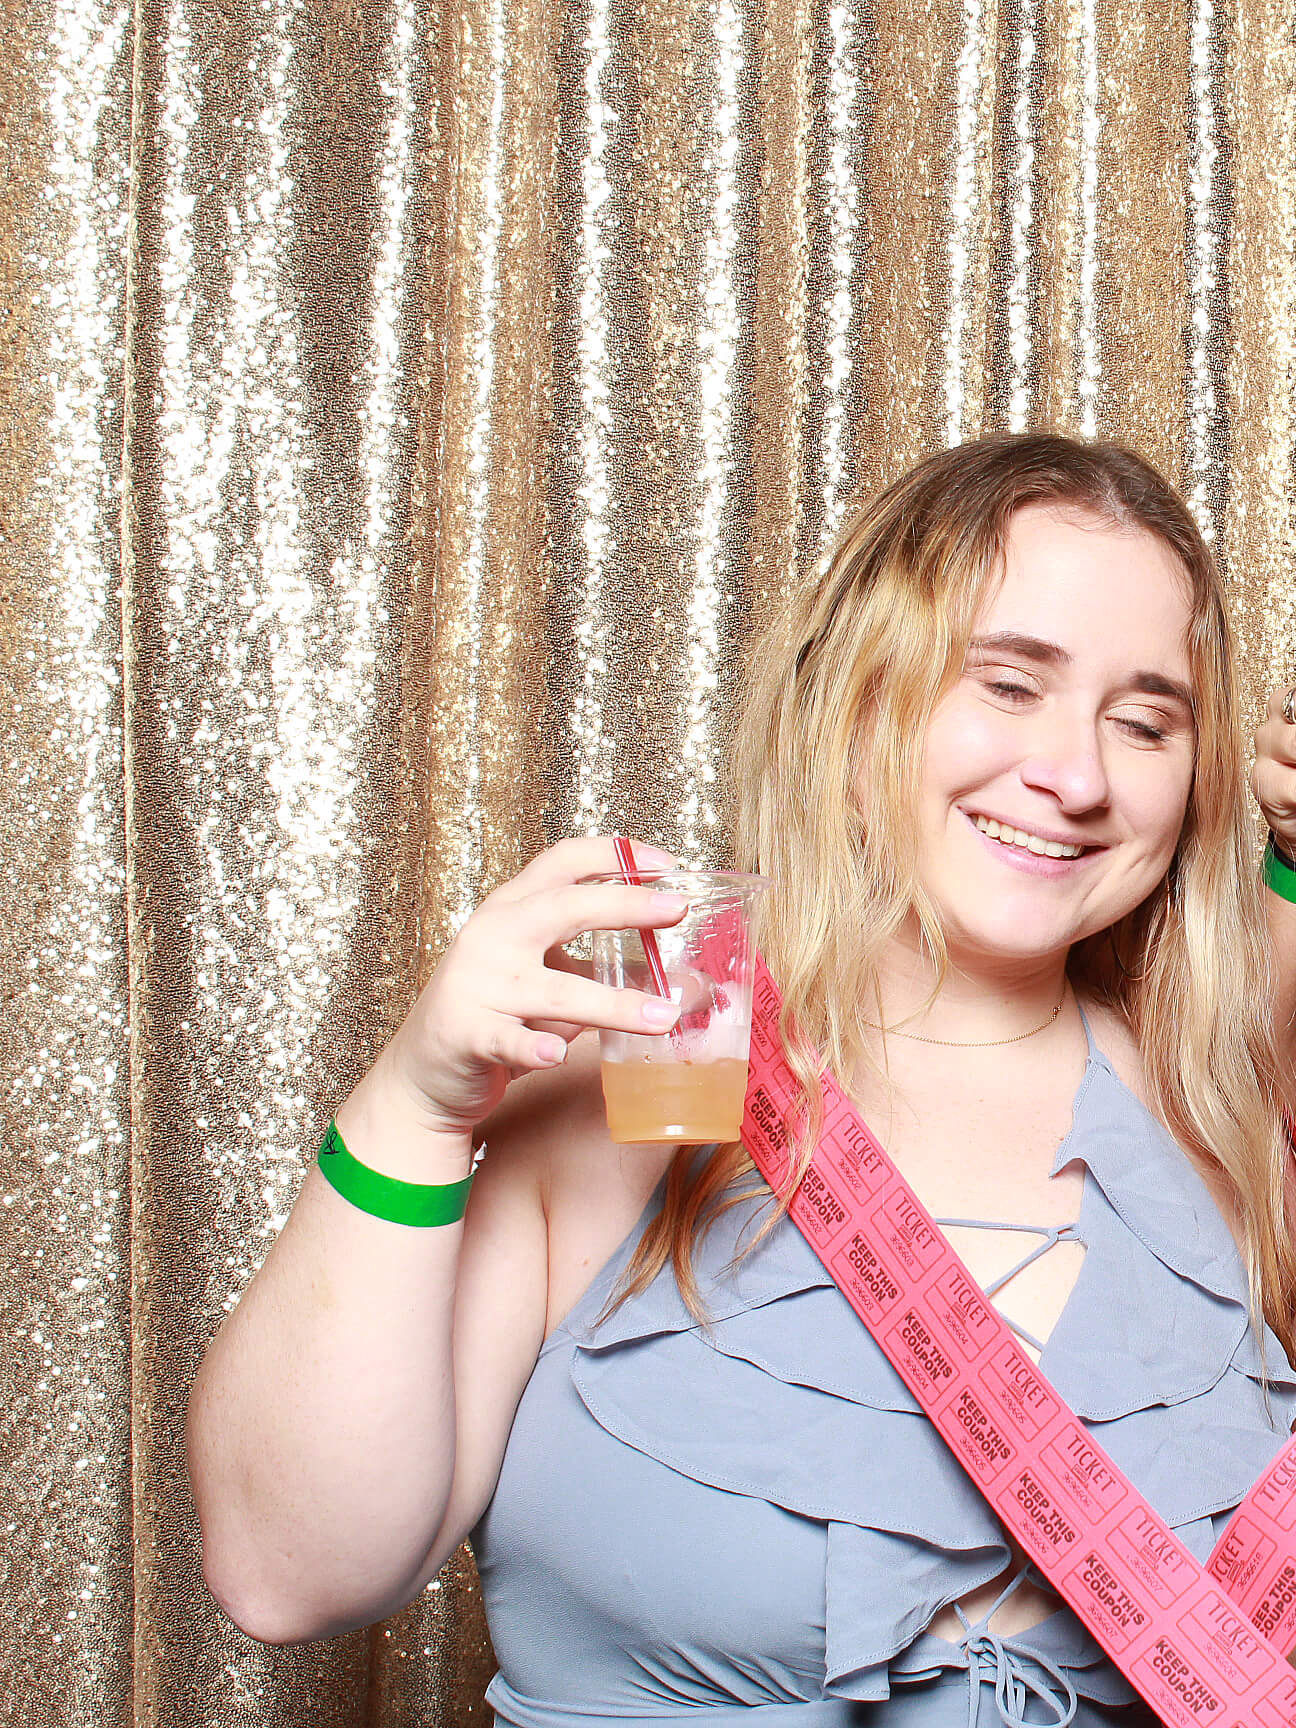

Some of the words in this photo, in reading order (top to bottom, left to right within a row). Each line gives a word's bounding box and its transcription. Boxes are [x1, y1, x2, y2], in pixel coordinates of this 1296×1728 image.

[748, 1102, 784, 1151] COUPON
[754, 1088, 777, 1120] KEEP
[842, 1122, 882, 1174] TICKET
[805, 1163, 825, 1192] EEP
[823, 1193, 845, 1223] THIS
[893, 1197, 935, 1250] TICKET
[847, 1249, 886, 1301] COUPON
[851, 1234, 877, 1268] KEEP
[874, 1268, 898, 1300] THIS
[947, 1274, 989, 1327] TICKET
[900, 1326, 940, 1380] COUPON
[904, 1311, 931, 1346] KEEP
[929, 1346, 952, 1378] THIS
[1002, 1352, 1048, 1408] TICKET
[955, 1406, 998, 1461] COUPON
[960, 1391, 988, 1427] KEEP
[986, 1426, 1011, 1460] THIS
[1065, 1434, 1116, 1492] TICKET
[1016, 1488, 1062, 1545] COUPON
[1019, 1472, 1050, 1510] KEEP
[1048, 1509, 1076, 1543] THIS
[1135, 1515, 1187, 1574] TICKET
[1208, 1531, 1245, 1584] ICKET
[1081, 1569, 1130, 1627] COUPON
[1085, 1554, 1118, 1592] KEEP
[1116, 1591, 1145, 1626] THIS
[1250, 1599, 1273, 1630] EEP
[1268, 1565, 1296, 1599] THIS
[1207, 1600, 1262, 1660] TICKET
[1151, 1654, 1202, 1713] COUPON
[1155, 1639, 1190, 1677] KEEP
[1188, 1676, 1219, 1711] THIS
